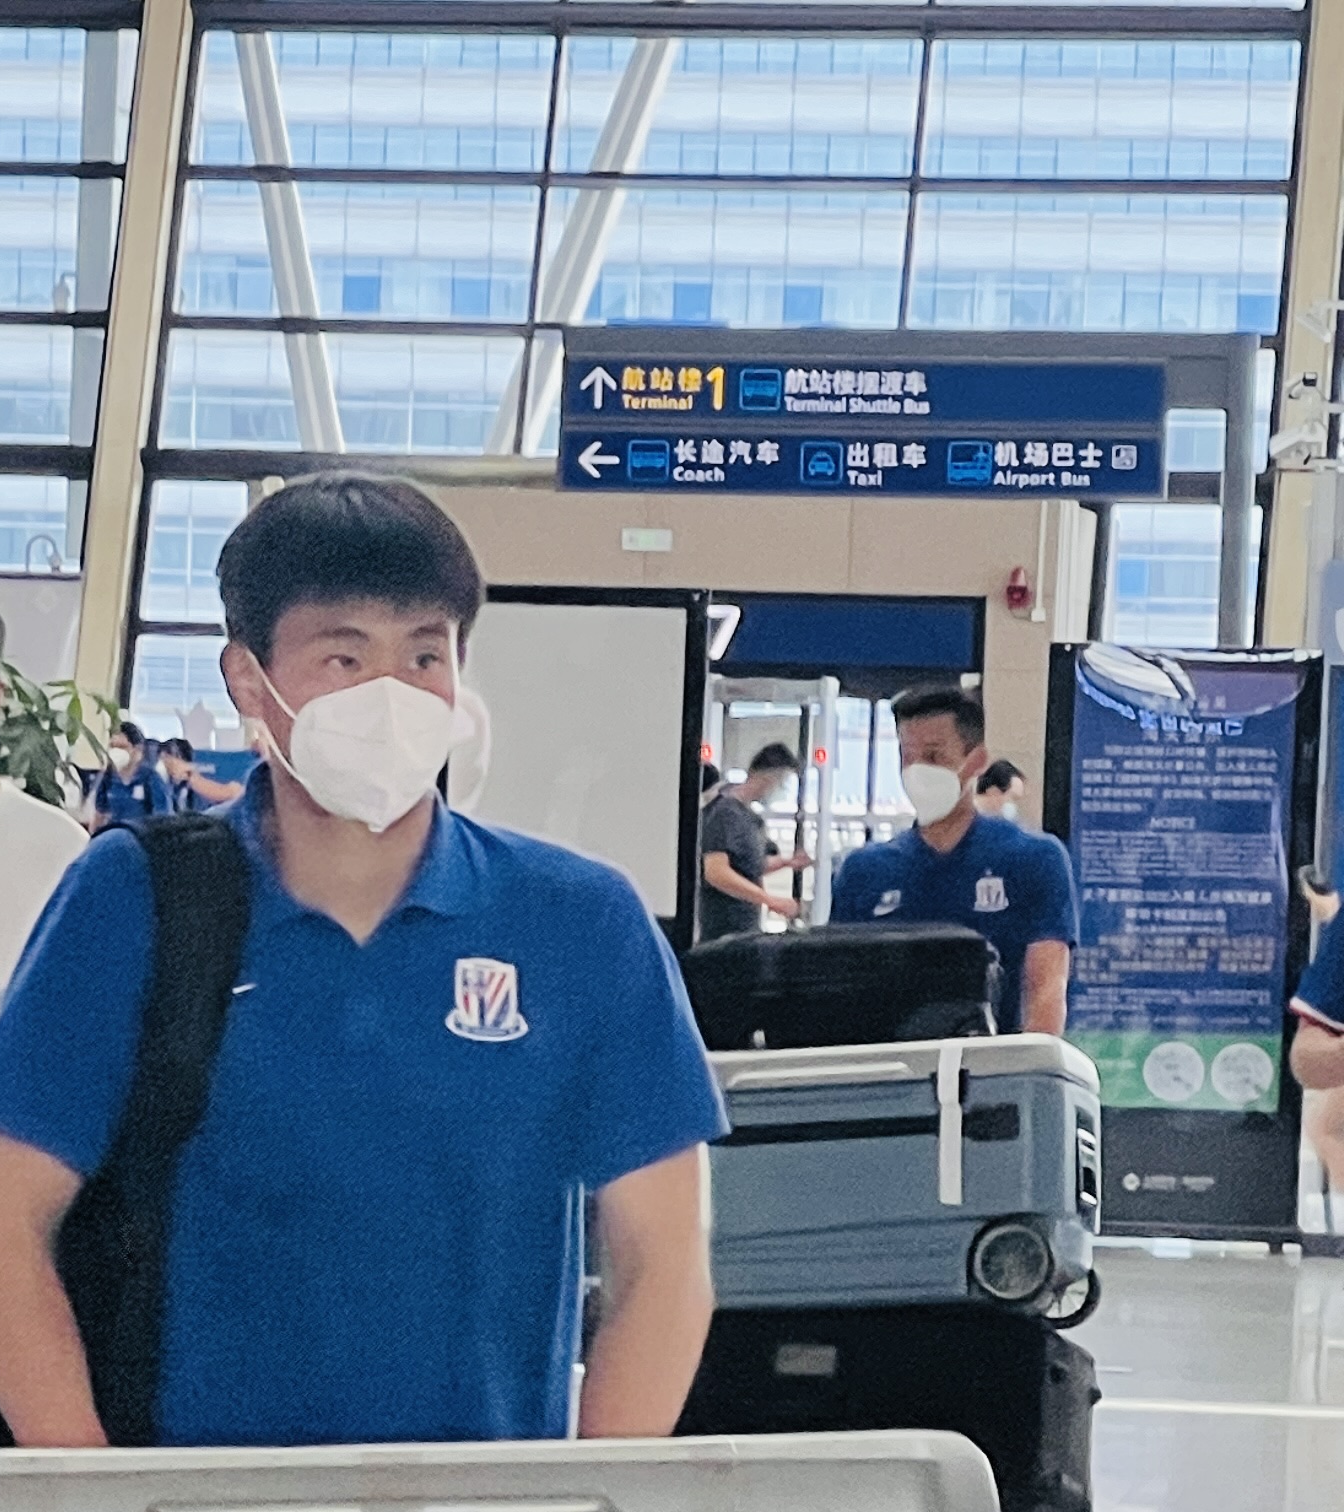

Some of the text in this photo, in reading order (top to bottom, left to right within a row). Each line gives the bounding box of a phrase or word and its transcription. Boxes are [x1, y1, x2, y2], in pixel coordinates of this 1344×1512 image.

[706, 366, 726, 411] 1
[622, 394, 694, 411] Terminal
[784, 396, 930, 414] Terminal Shuttle Bus
[673, 438, 780, 466] 长途汽车
[846, 441, 928, 469] 出租车
[994, 441, 1104, 469] 机场巴士
[673, 465, 725, 483] Coach
[847, 470, 883, 486] Taxi
[993, 470, 1091, 489] Airport Bus
